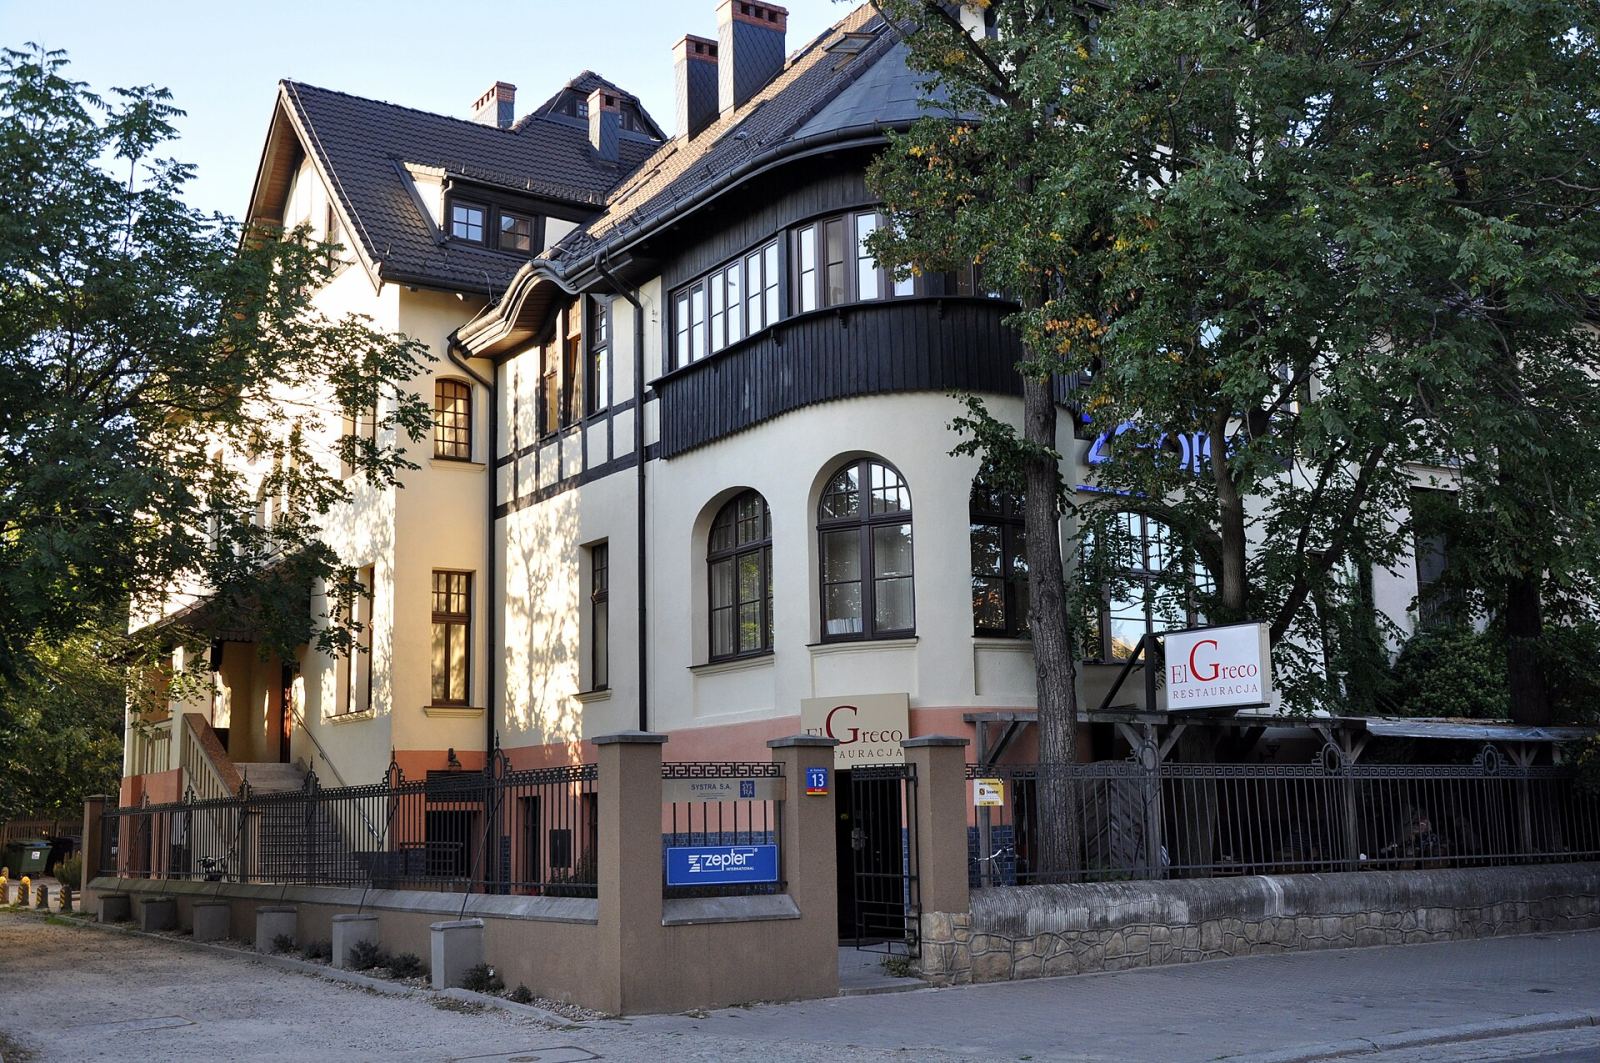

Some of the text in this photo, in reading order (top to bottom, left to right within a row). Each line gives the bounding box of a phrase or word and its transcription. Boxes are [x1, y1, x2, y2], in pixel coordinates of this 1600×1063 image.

[1171, 639, 1257, 684] El Greco
[1173, 684, 1258, 699] RESTAURACJA
[826, 705, 903, 744] Greco
[834, 748, 903, 758] AURACJA
[811, 773, 824, 787] 13
[701, 848, 754, 872] zepter
